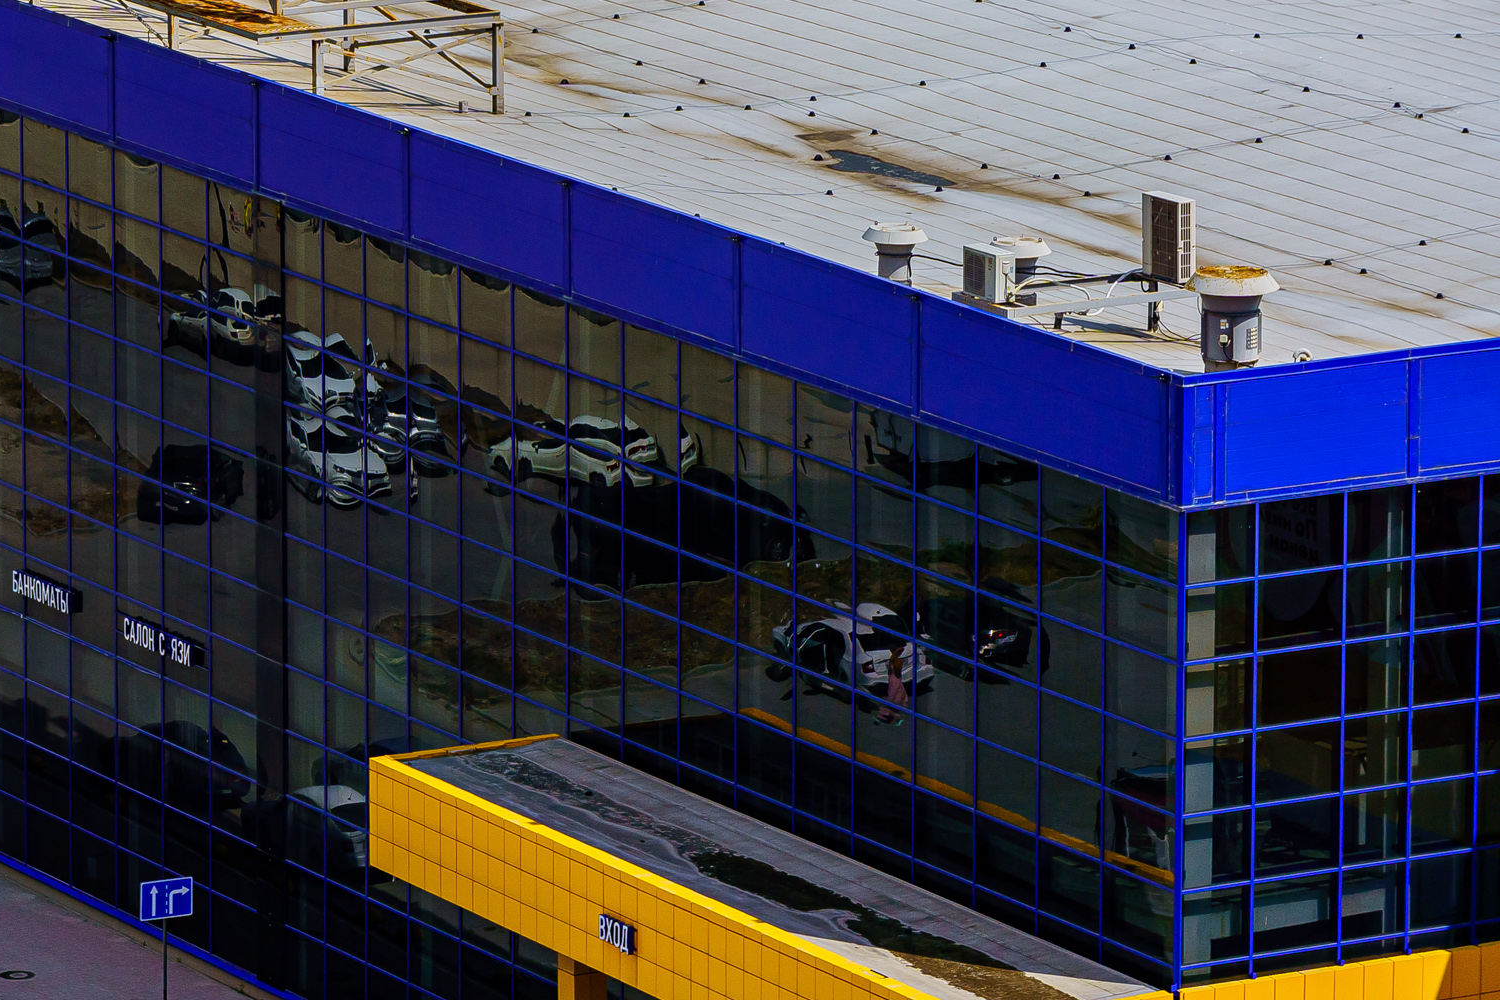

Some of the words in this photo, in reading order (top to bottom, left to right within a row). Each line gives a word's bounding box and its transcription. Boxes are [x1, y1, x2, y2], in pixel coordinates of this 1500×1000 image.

[12, 569, 69, 615] БАНКОМАТЫ
[123, 617, 155, 652] САЛОН
[158, 632, 191, 667] СЯЗИ
[598, 914, 629, 956] ВХОД
